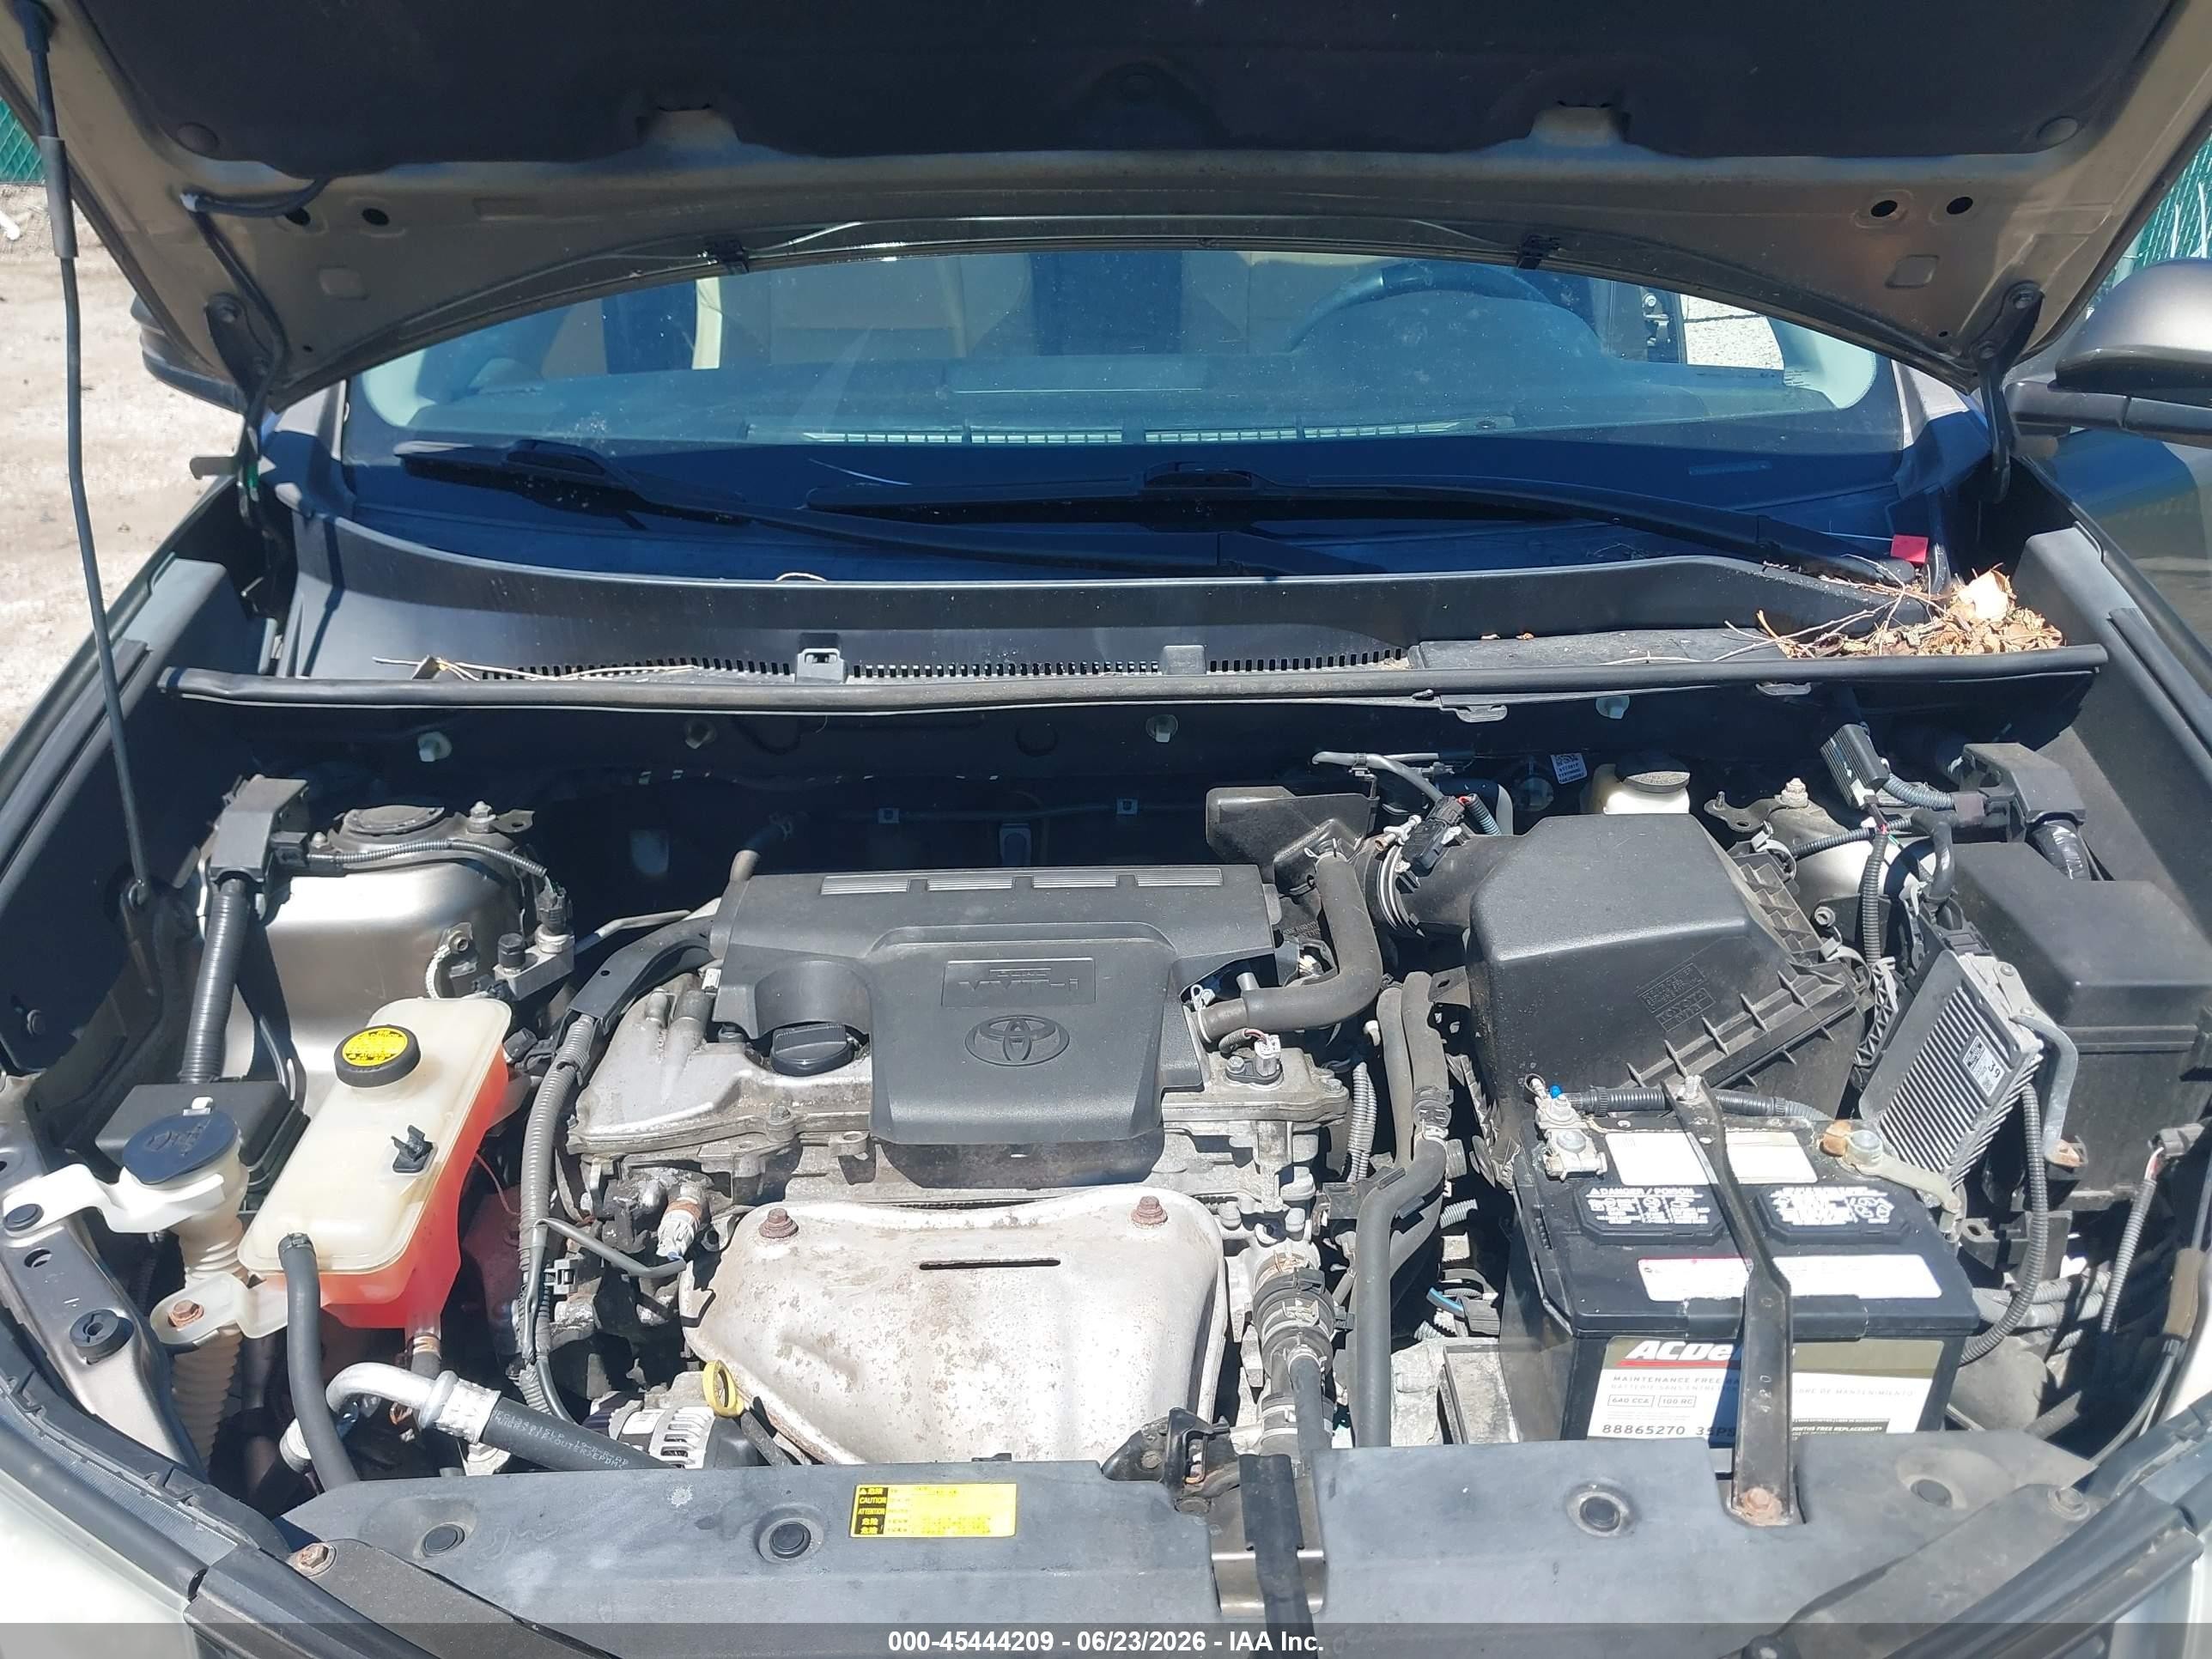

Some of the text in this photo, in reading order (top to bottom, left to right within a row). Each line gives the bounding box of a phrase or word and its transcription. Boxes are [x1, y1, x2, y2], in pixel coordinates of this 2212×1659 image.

[1988, 1060, 2001, 1079] 39
[1625, 1340, 1735, 1361] ACDe
[1601, 1424, 1686, 1436] 88865270
